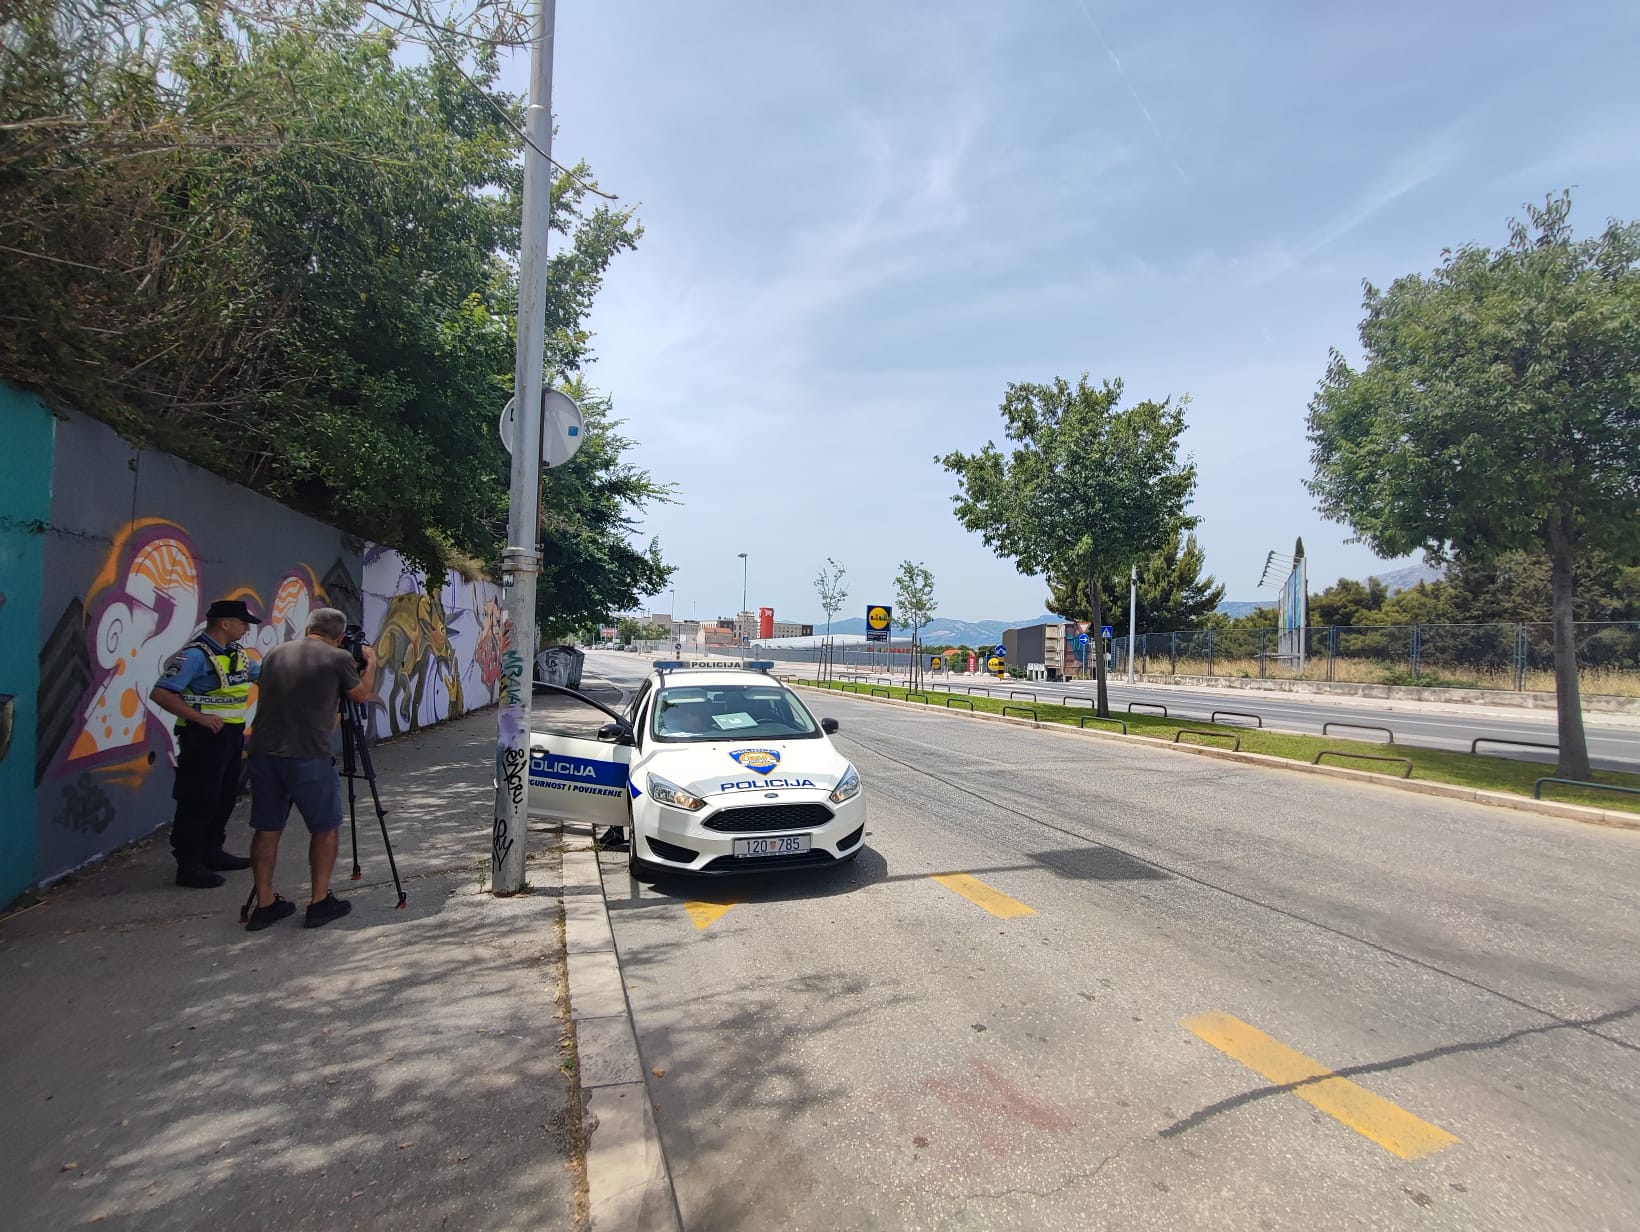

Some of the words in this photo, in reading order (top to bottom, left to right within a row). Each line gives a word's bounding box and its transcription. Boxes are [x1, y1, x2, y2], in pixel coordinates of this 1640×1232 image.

[530, 758, 597, 778] OLICIJA
[529, 779, 567, 791] GURNOST
[572, 785, 622, 798] POVJERENJE
[720, 779, 816, 792] POLICIJA
[746, 840, 768, 853] 120
[778, 837, 800, 851] 785
